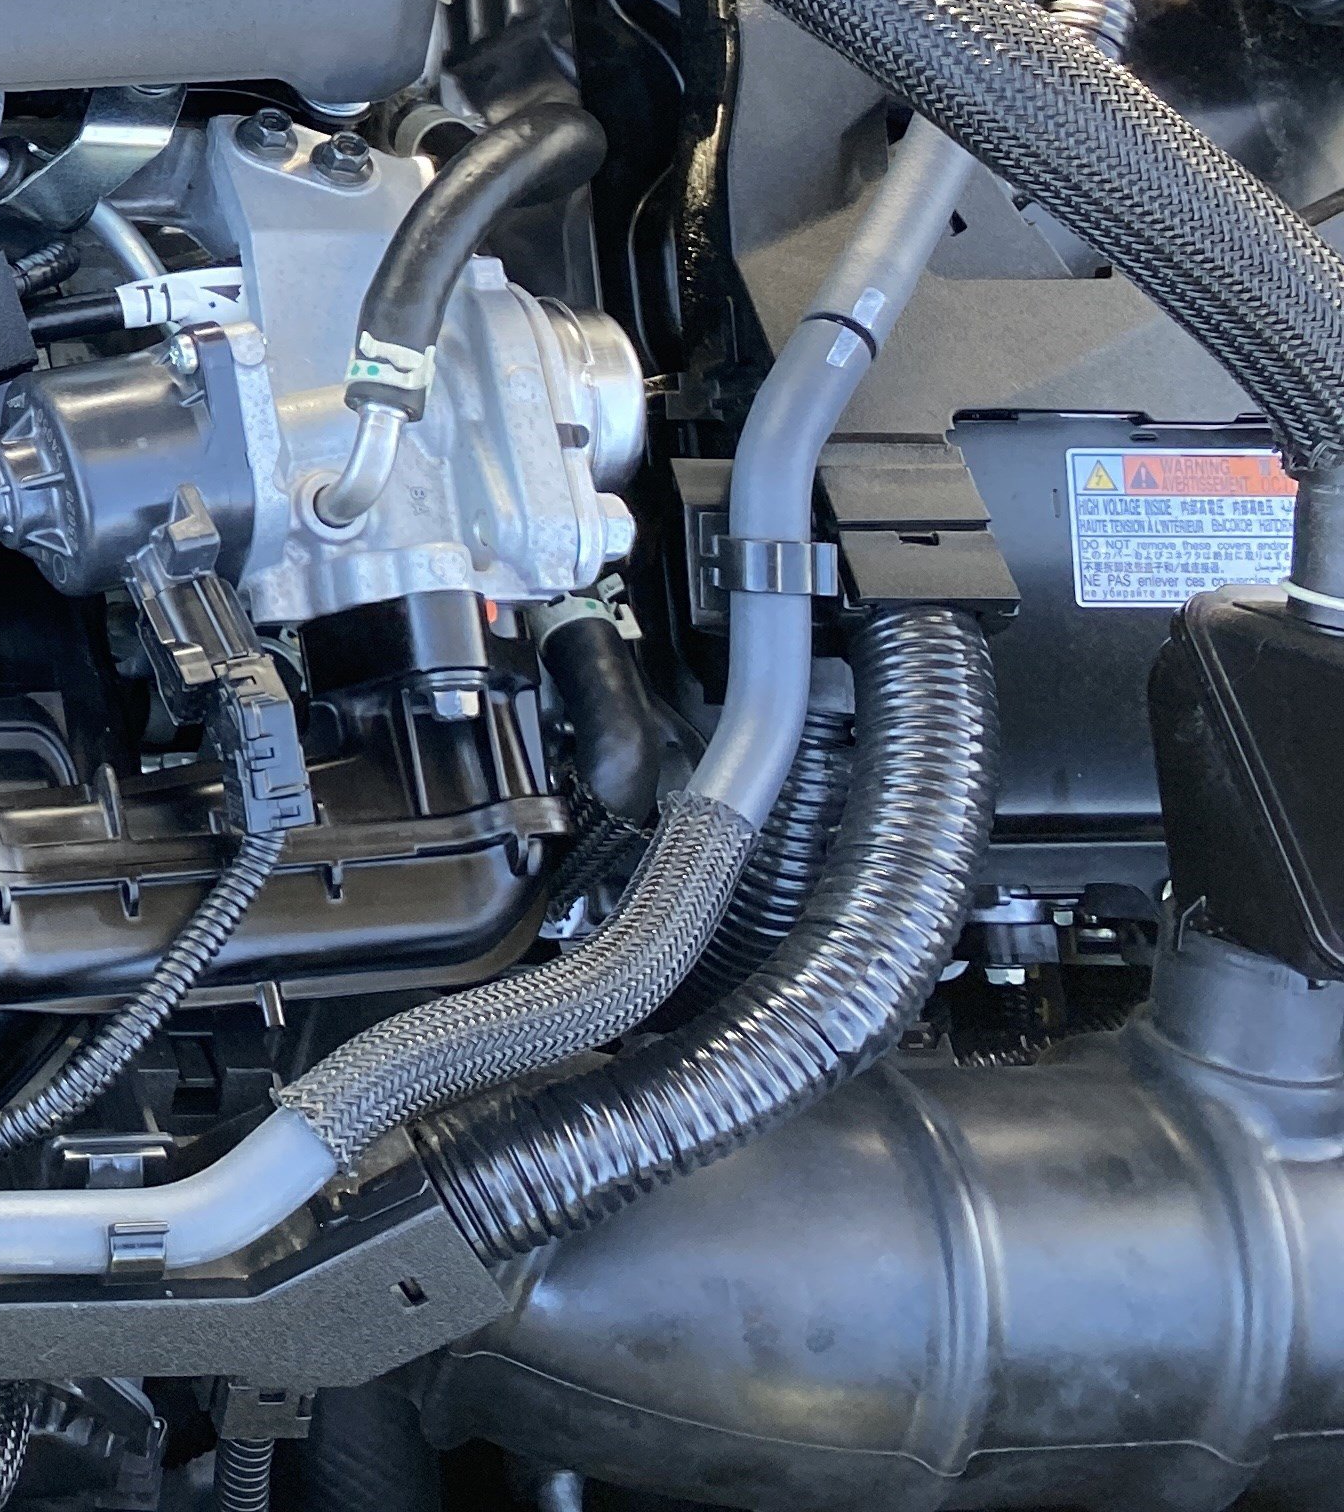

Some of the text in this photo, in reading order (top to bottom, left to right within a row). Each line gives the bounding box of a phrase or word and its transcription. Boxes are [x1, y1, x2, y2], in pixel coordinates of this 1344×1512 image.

[136, 282, 172, 323] T1
[1160, 458, 1230, 476] WARNING
[1078, 498, 1172, 516] HIGH VOLTAGE INSIDE
[1078, 519, 1108, 533] HAUTE
[1109, 519, 1145, 533] TENSION
[1081, 539, 1099, 550] DO
[1105, 539, 1131, 550] NOT
[1137, 541, 1177, 550] remove
[1182, 540, 1211, 550] these
[1217, 542, 1251, 550] covers
[1084, 574, 1101, 587] NE
[1107, 574, 1131, 587] PAS
[1138, 575, 1179, 587] enlever
[1185, 577, 1205, 587] ces
